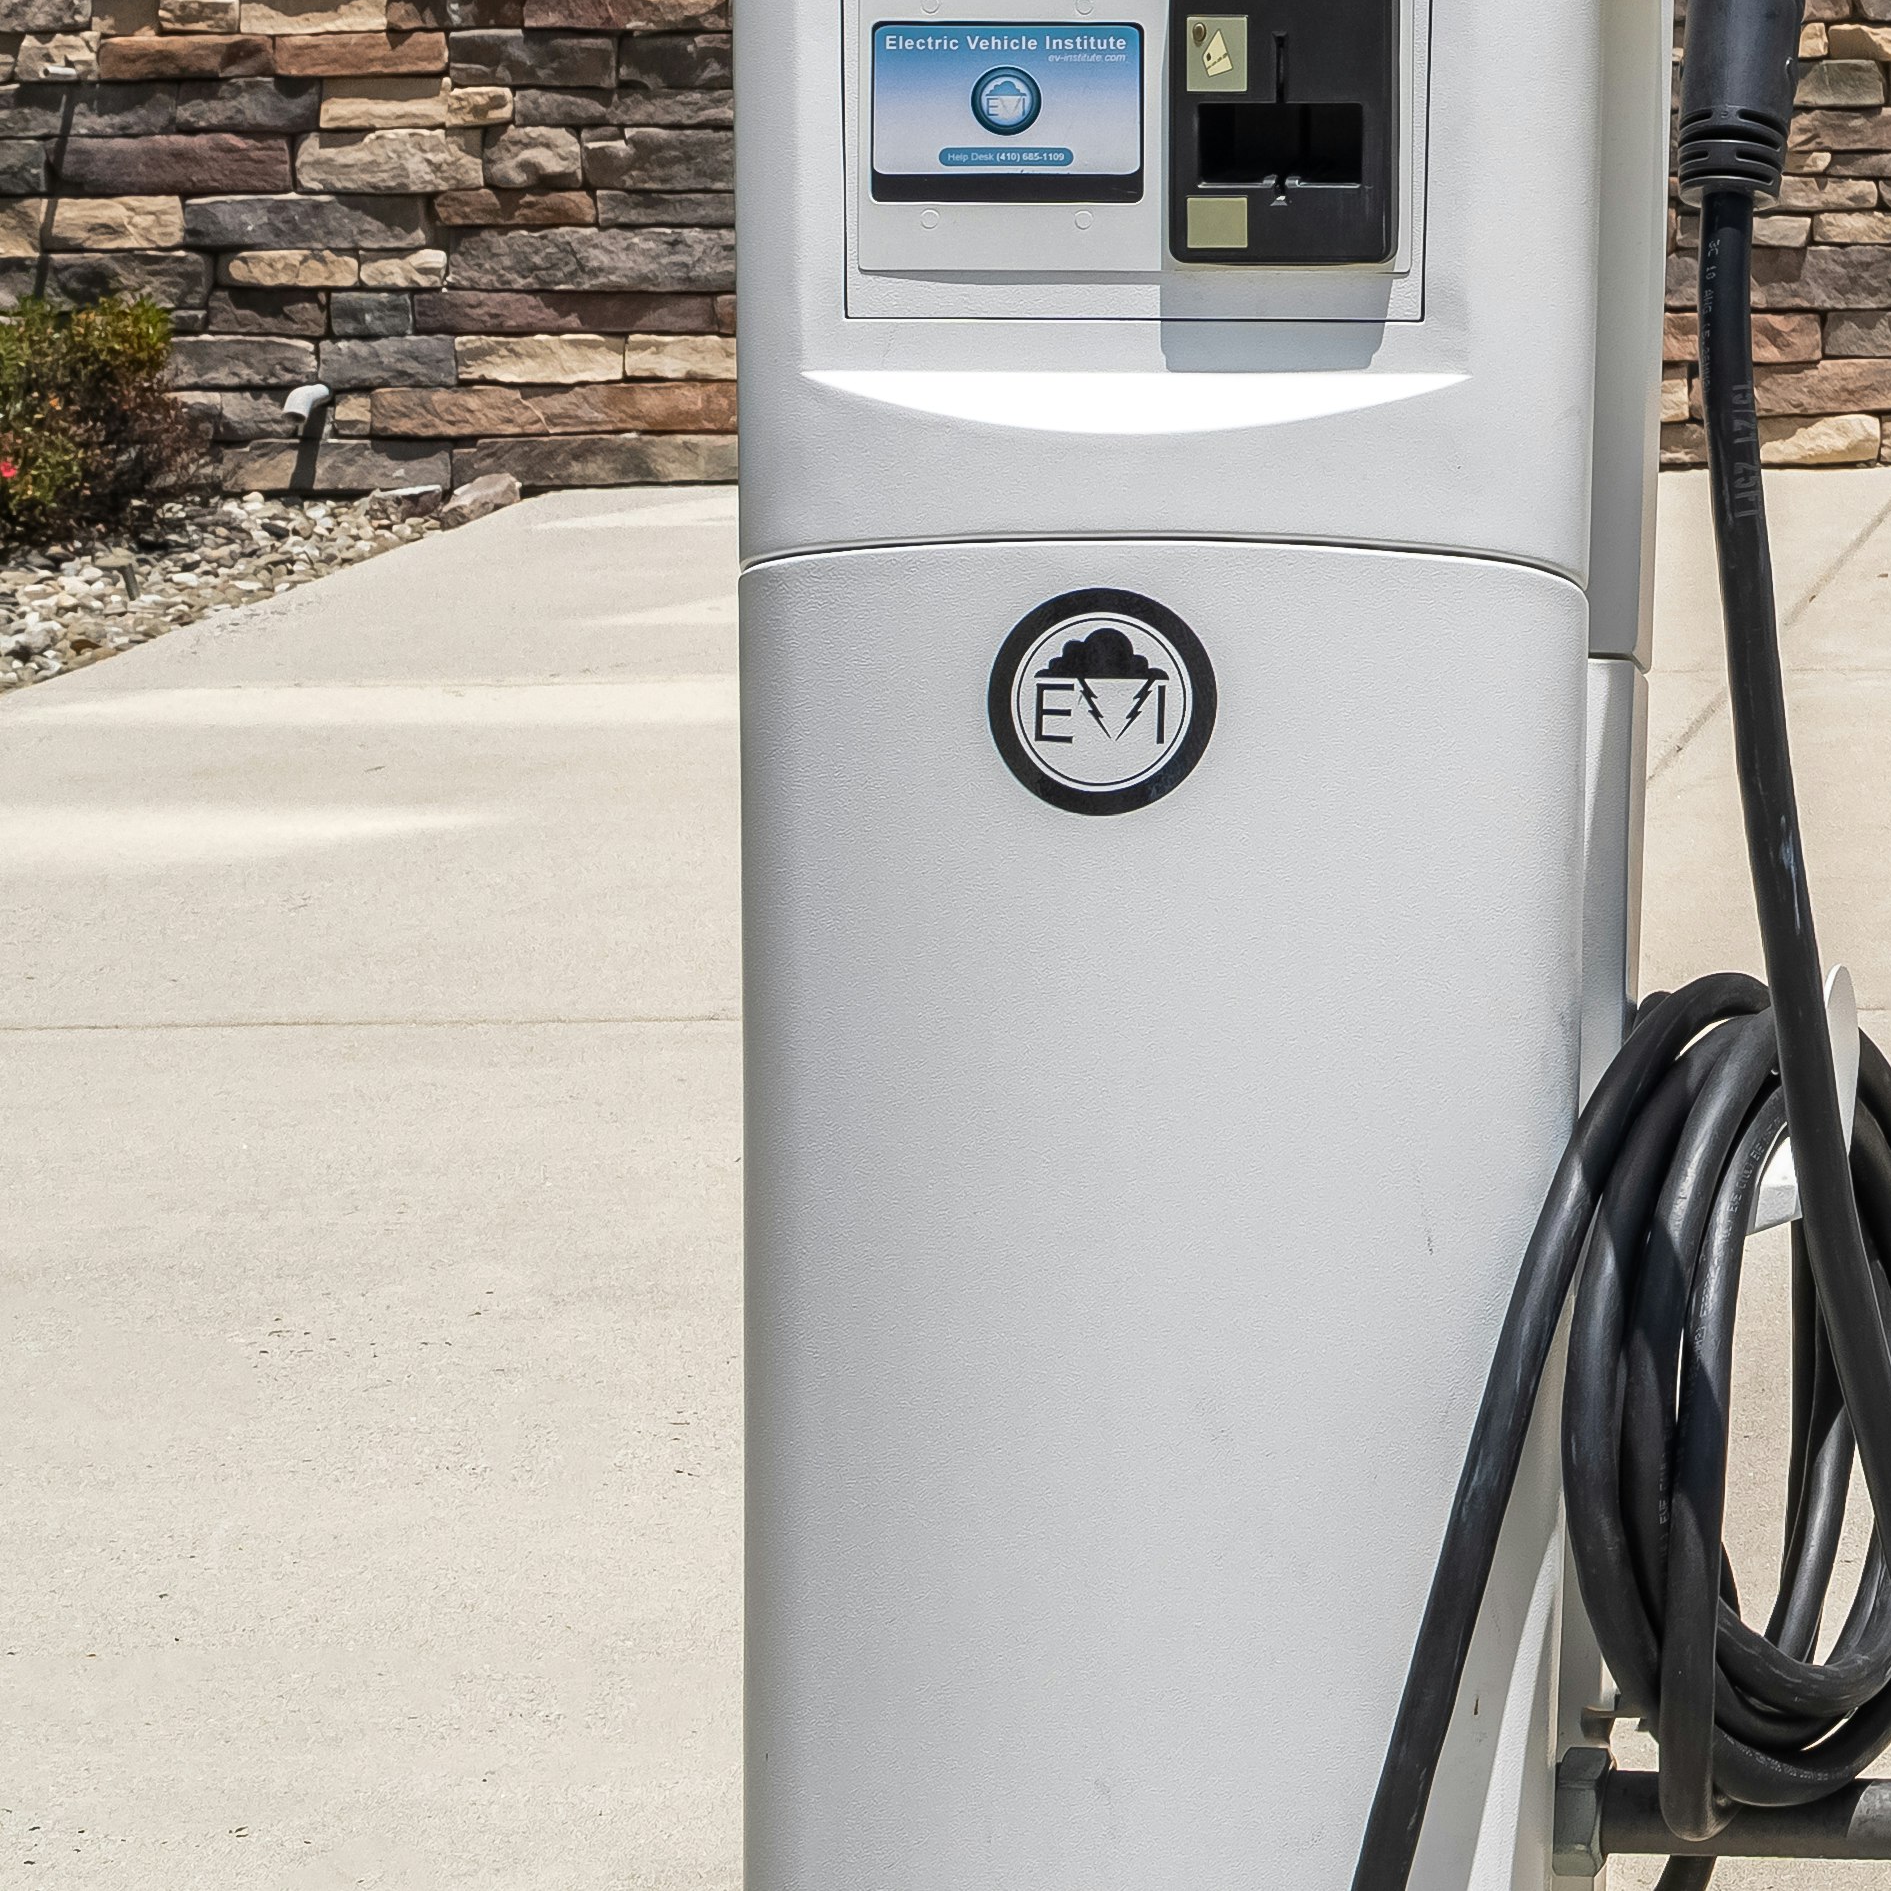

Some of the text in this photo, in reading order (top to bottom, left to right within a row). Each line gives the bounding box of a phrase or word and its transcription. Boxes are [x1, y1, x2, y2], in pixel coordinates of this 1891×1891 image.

[885, 34, 1127, 51] Electric Vehicle Institute
[1048, 52, 1126, 62] ev-institute.com
[947, 152, 969, 162] Help
[971, 152, 996, 161] Desk
[996, 152, 1021, 163] (410)
